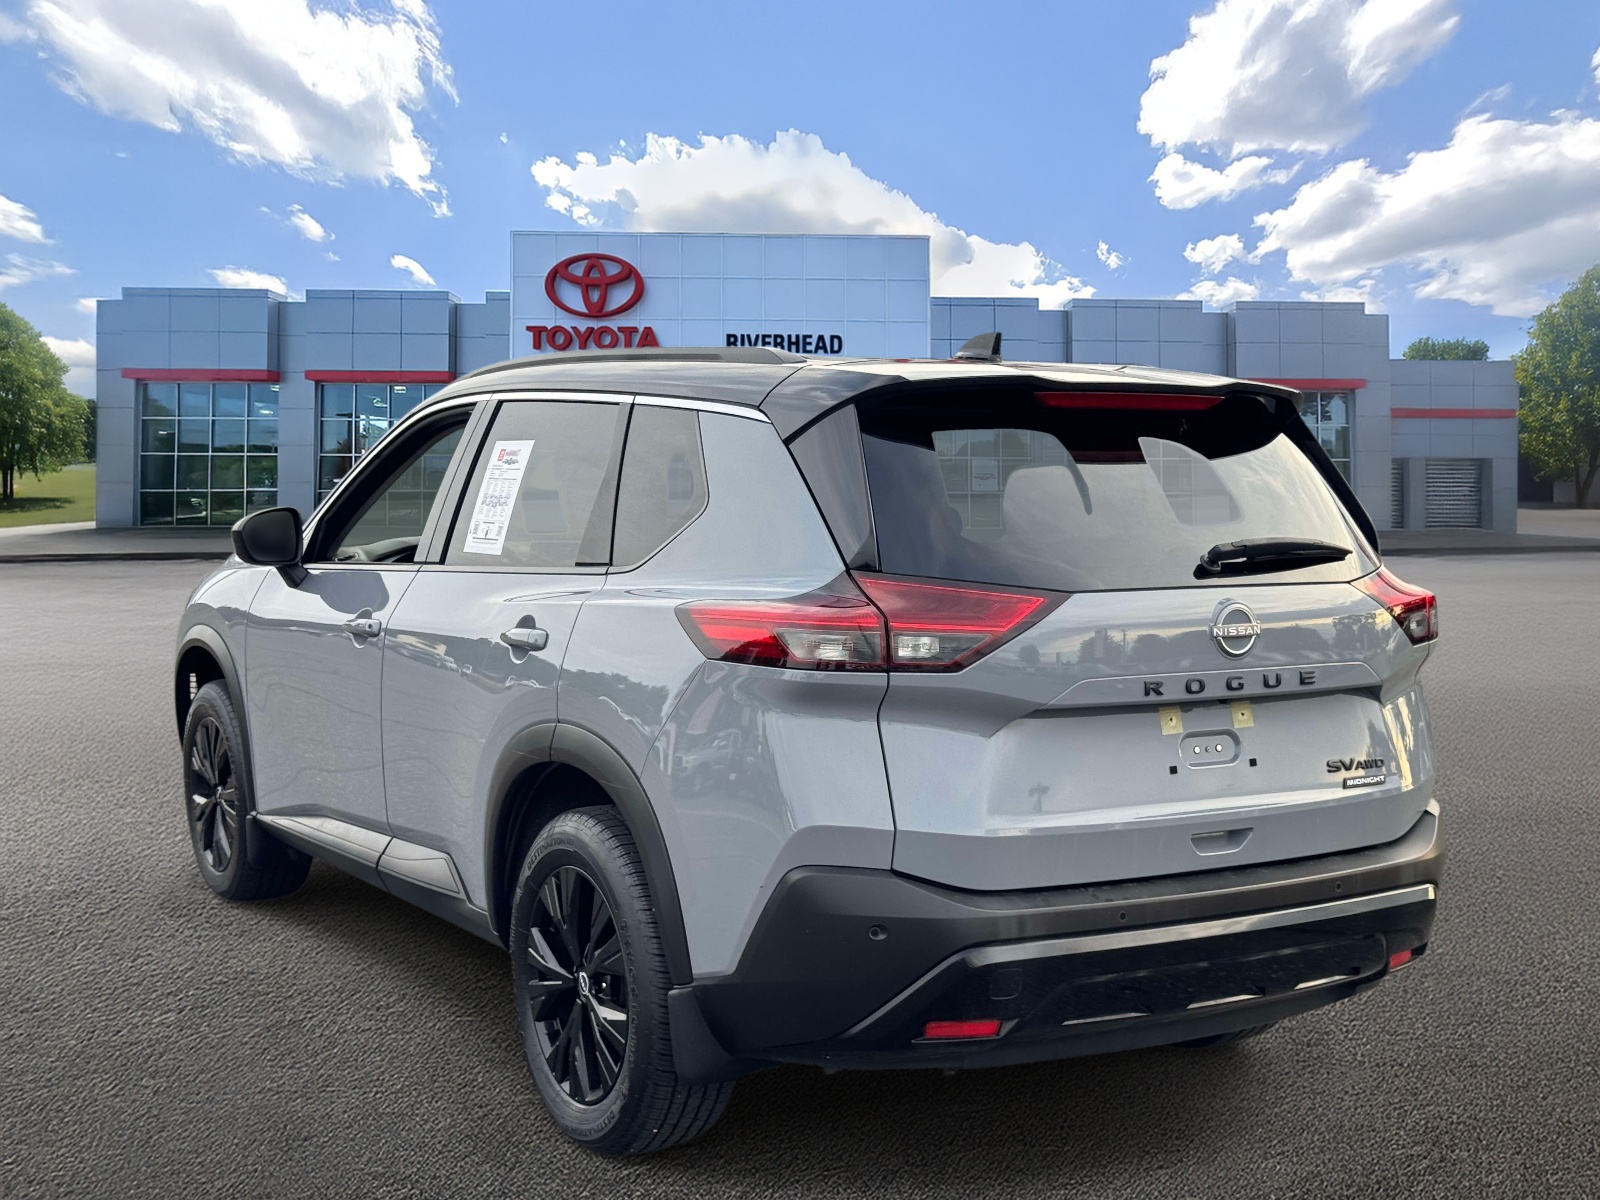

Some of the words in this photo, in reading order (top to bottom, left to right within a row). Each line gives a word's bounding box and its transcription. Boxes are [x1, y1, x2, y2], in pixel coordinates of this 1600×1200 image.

[526, 325, 659, 350] TOYOTA
[726, 333, 843, 354] RIVERHEAD
[1213, 624, 1261, 638] NISSAN
[1143, 670, 1316, 697] ROGUE
[1326, 757, 1355, 773] SV
[1355, 758, 1385, 771] AWD
[1346, 775, 1385, 786] MIDNIGHT
